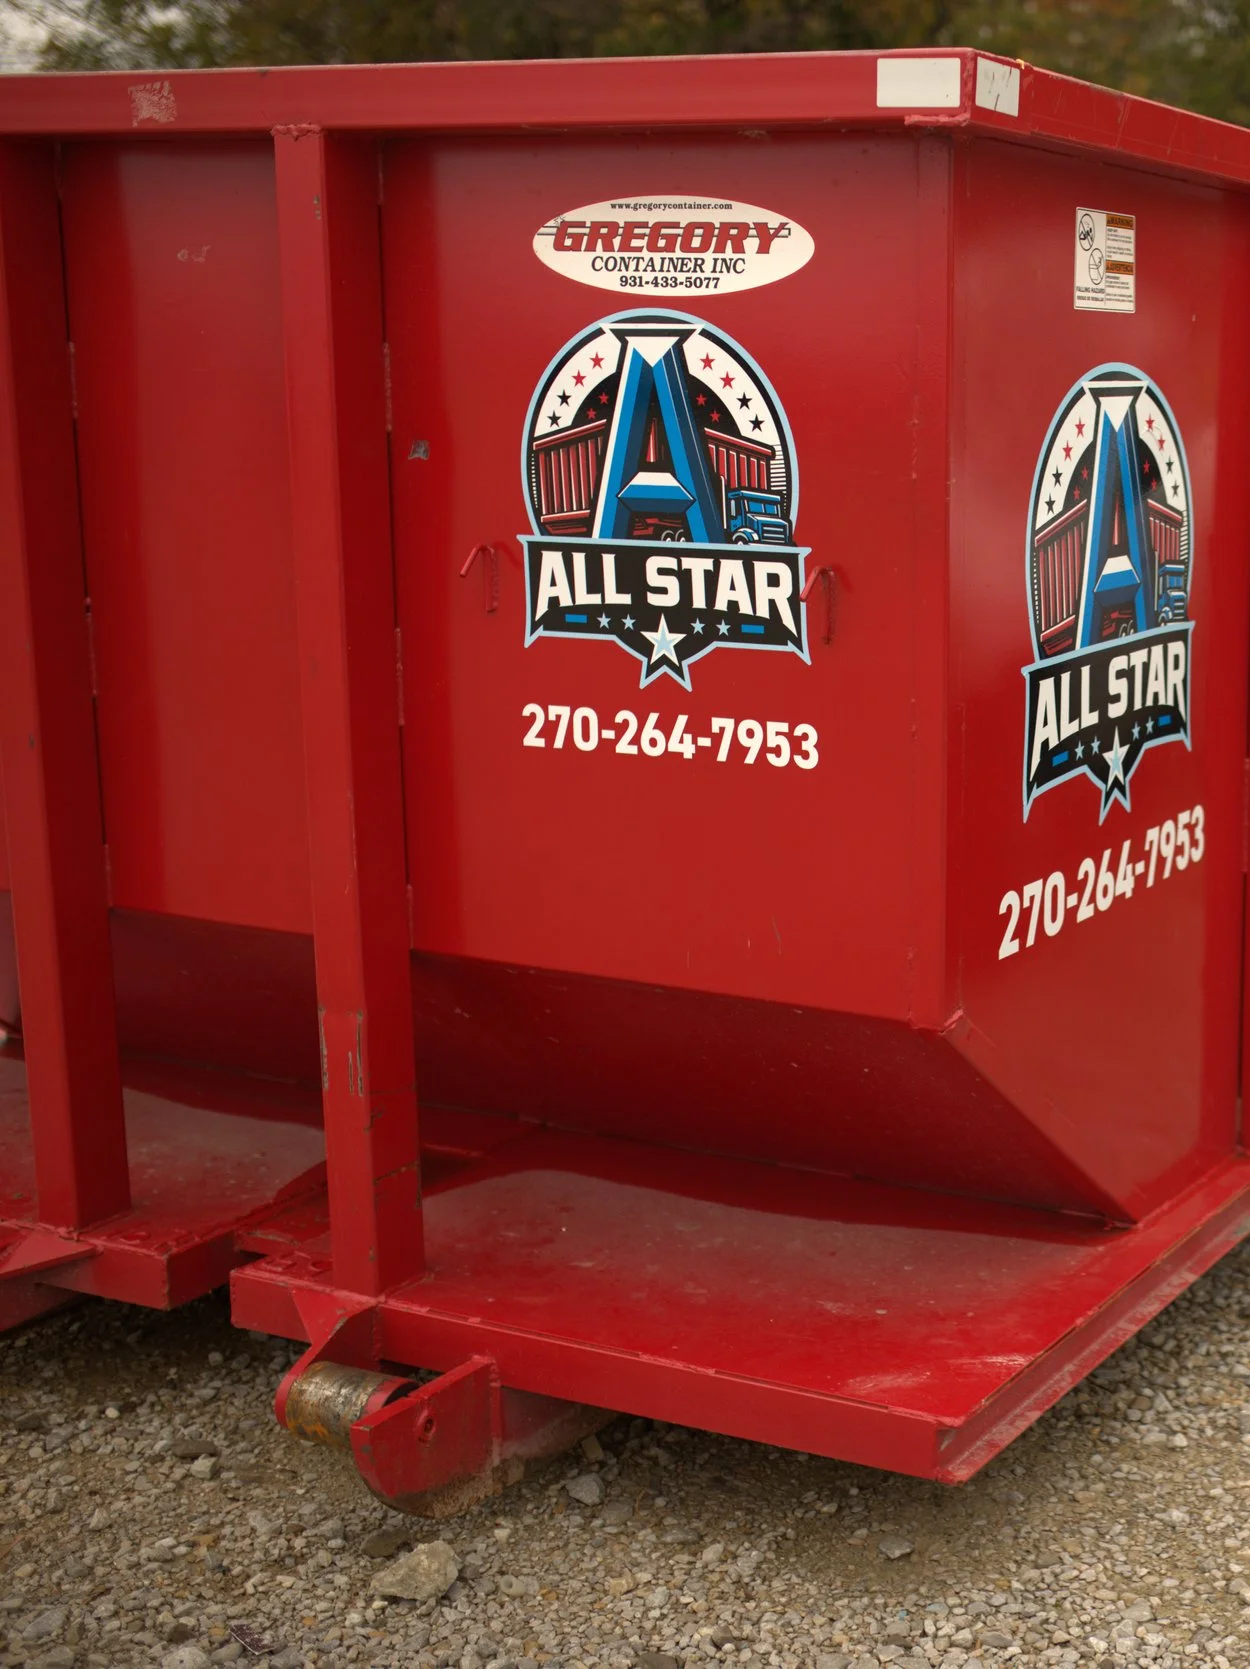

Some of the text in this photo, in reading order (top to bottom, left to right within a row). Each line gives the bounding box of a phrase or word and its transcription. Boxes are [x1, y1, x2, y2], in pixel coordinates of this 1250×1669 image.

[610, 201, 733, 211] www.gregorycontainer.com
[552, 220, 789, 254] GREGORY
[591, 255, 746, 274] CONTAINER INC
[619, 275, 721, 289] 931-433-5077
[535, 550, 798, 638] ALL STAR
[521, 702, 819, 770] 270-264-7953
[1029, 640, 1187, 782] ALL STAR
[998, 804, 1205, 961] 270-264-7953
